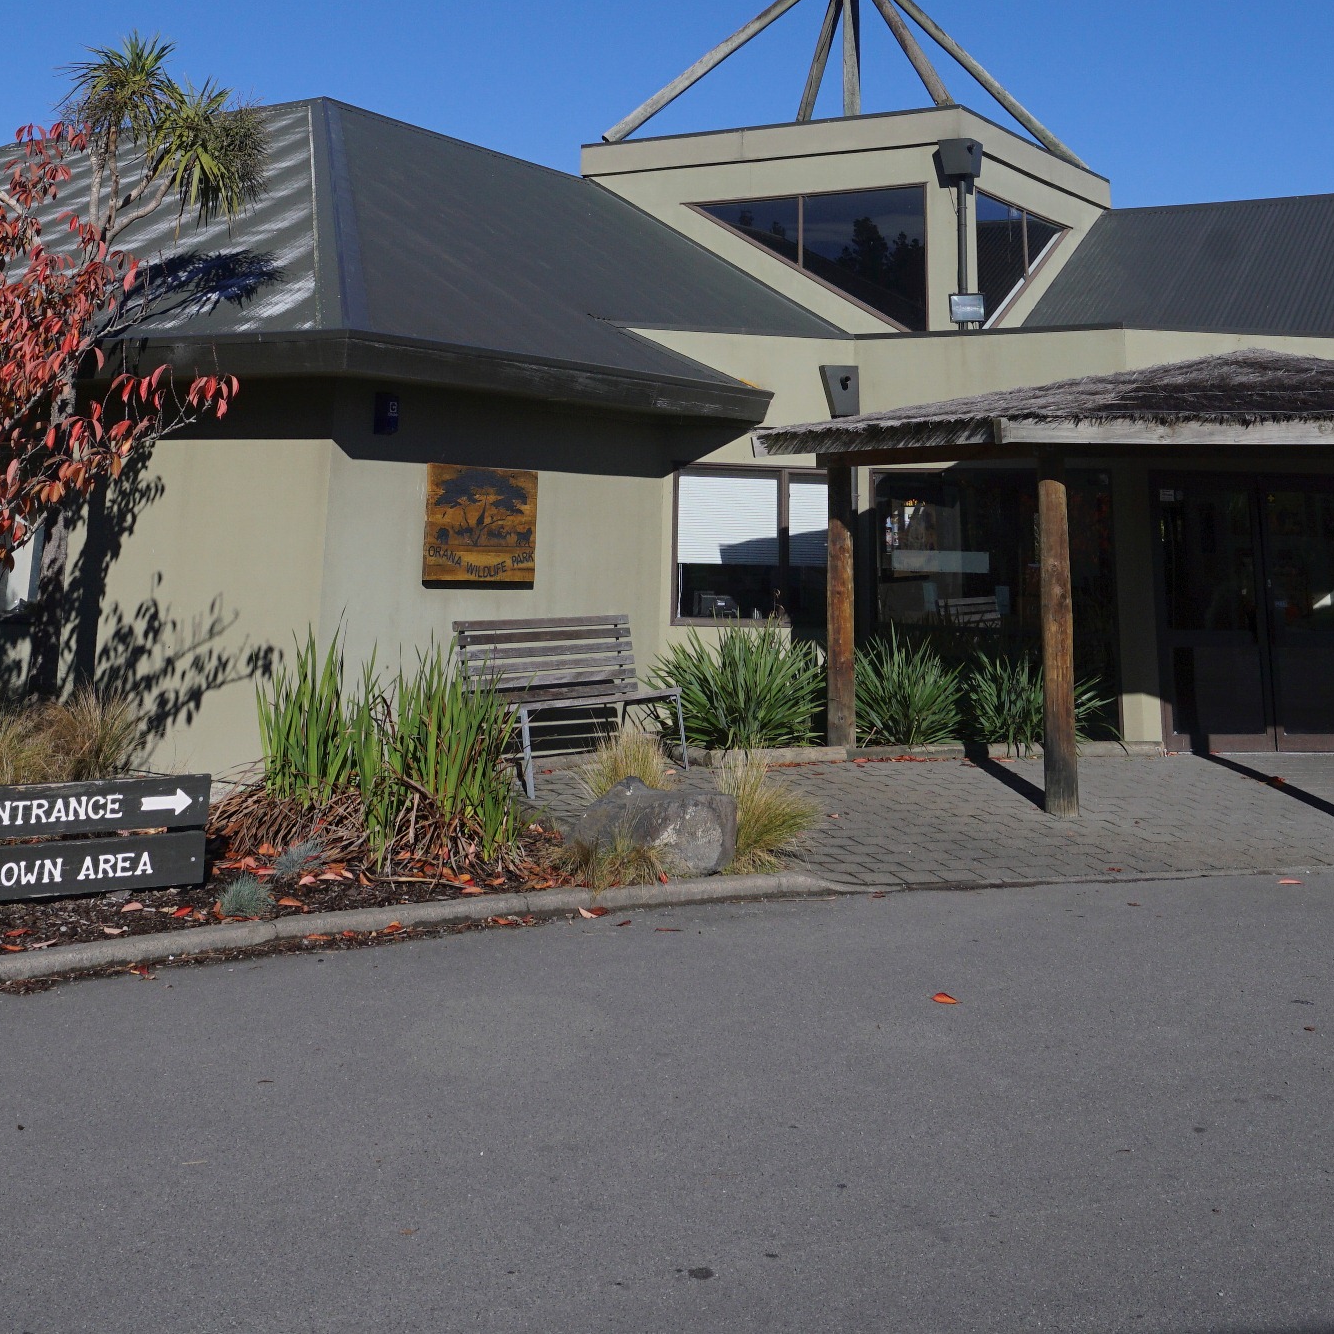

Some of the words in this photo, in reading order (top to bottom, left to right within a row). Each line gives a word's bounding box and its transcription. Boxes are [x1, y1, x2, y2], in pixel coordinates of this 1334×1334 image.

[428, 545, 462, 568] ORANA
[466, 561, 507, 578] WILDLIFE
[511, 551, 534, 567] PARK
[77, 852, 153, 880] AREA
